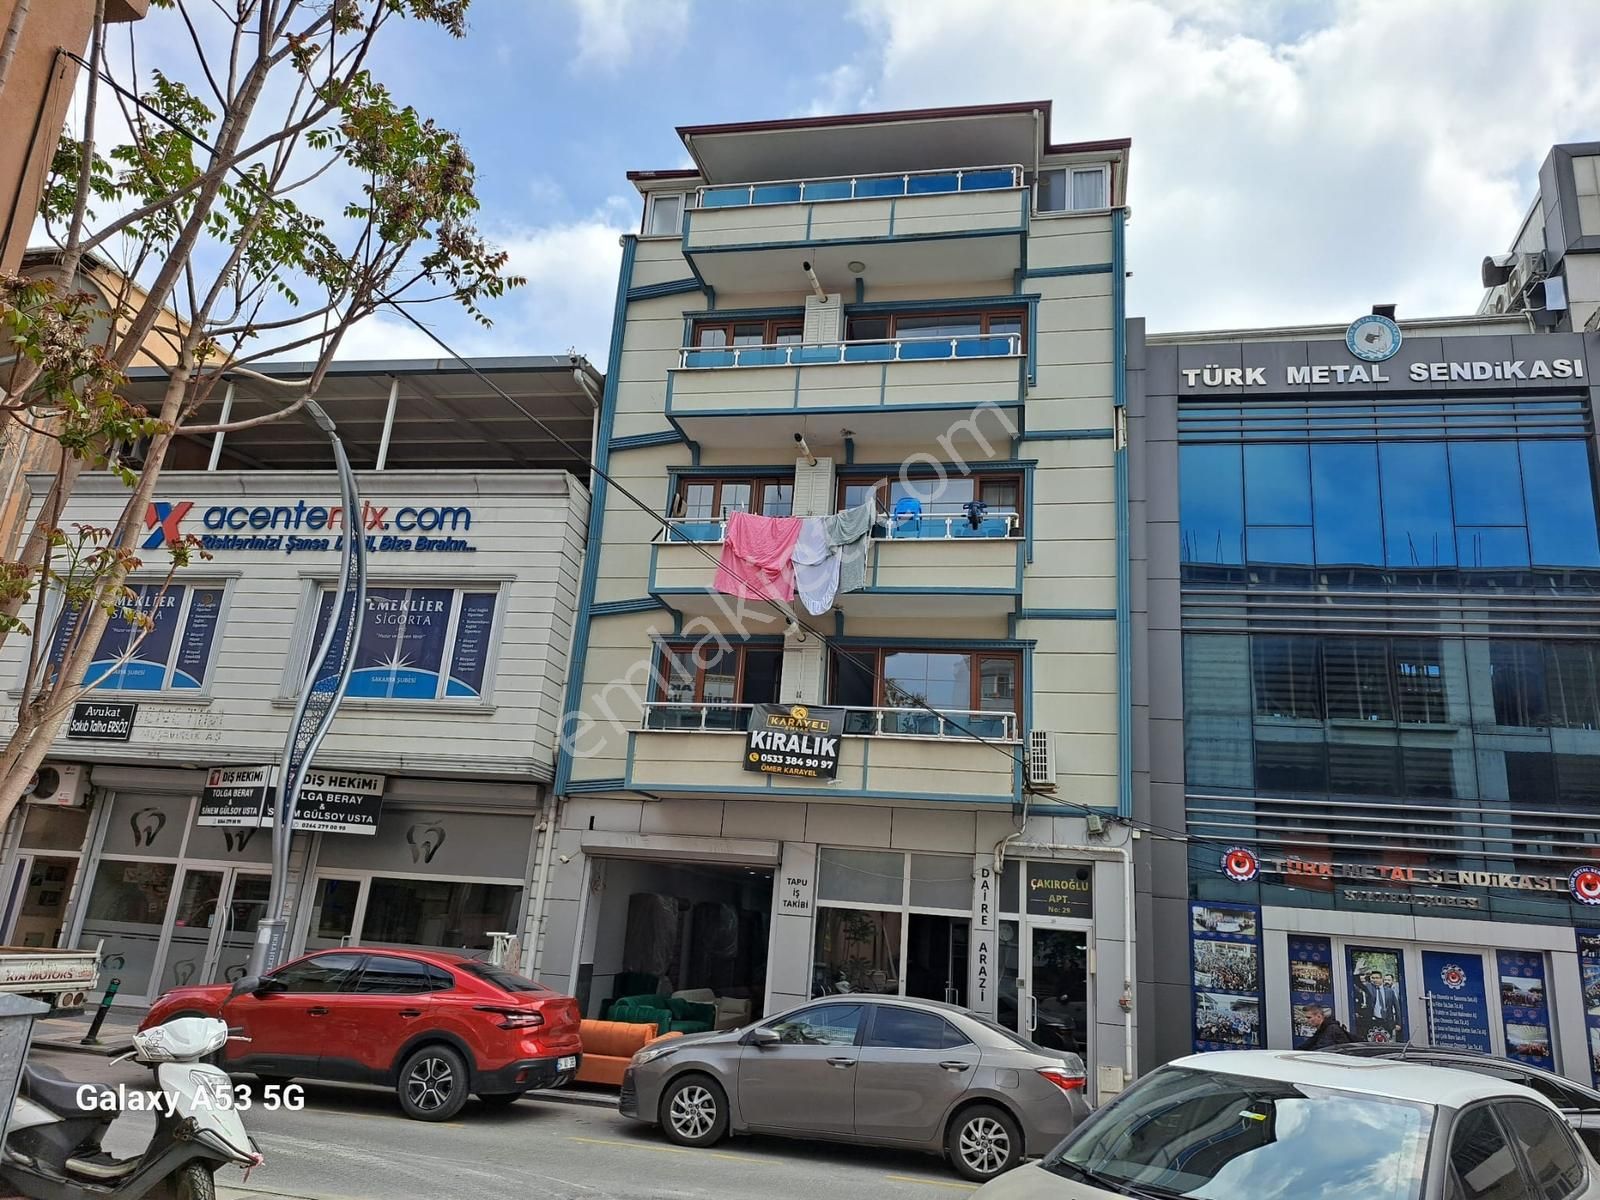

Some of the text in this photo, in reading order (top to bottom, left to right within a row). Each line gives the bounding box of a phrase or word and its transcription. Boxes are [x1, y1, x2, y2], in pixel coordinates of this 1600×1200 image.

[1182, 364, 1268, 387] TÜRK
[1287, 364, 1390, 385] METAL
[285, 534, 330, 555] Şansa
[379, 535, 412, 552] Bize
[368, 596, 444, 612] EMEKLİER
[375, 613, 432, 626] SİGORTA
[85, 706, 120, 717] Avukat
[770, 716, 827, 730] KARAYEL
[761, 753, 834, 769] 0533 384 90 97
[760, 763, 817, 777] ÖMER KARAYEL
[212, 788, 254, 798] TOLGA BERAY
[326, 793, 363, 805] BERAY
[219, 805, 242, 815] GÜLSOY
[242, 807, 258, 815] USTA
[303, 809, 345, 821] GÜLSOY
[347, 814, 374, 824] USTA
[1271, 855, 1335, 876] TÜRK
[786, 877, 808, 887] TAPU
[1030, 878, 1089, 892] ÇAKIROĞLU
[792, 888, 800, 899] İŞ
[980, 868, 990, 926] DAİRE
[1048, 894, 1071, 904] APT.
[783, 899, 809, 909] TAKİBİ
[978, 942, 988, 1002] ARAZİ
